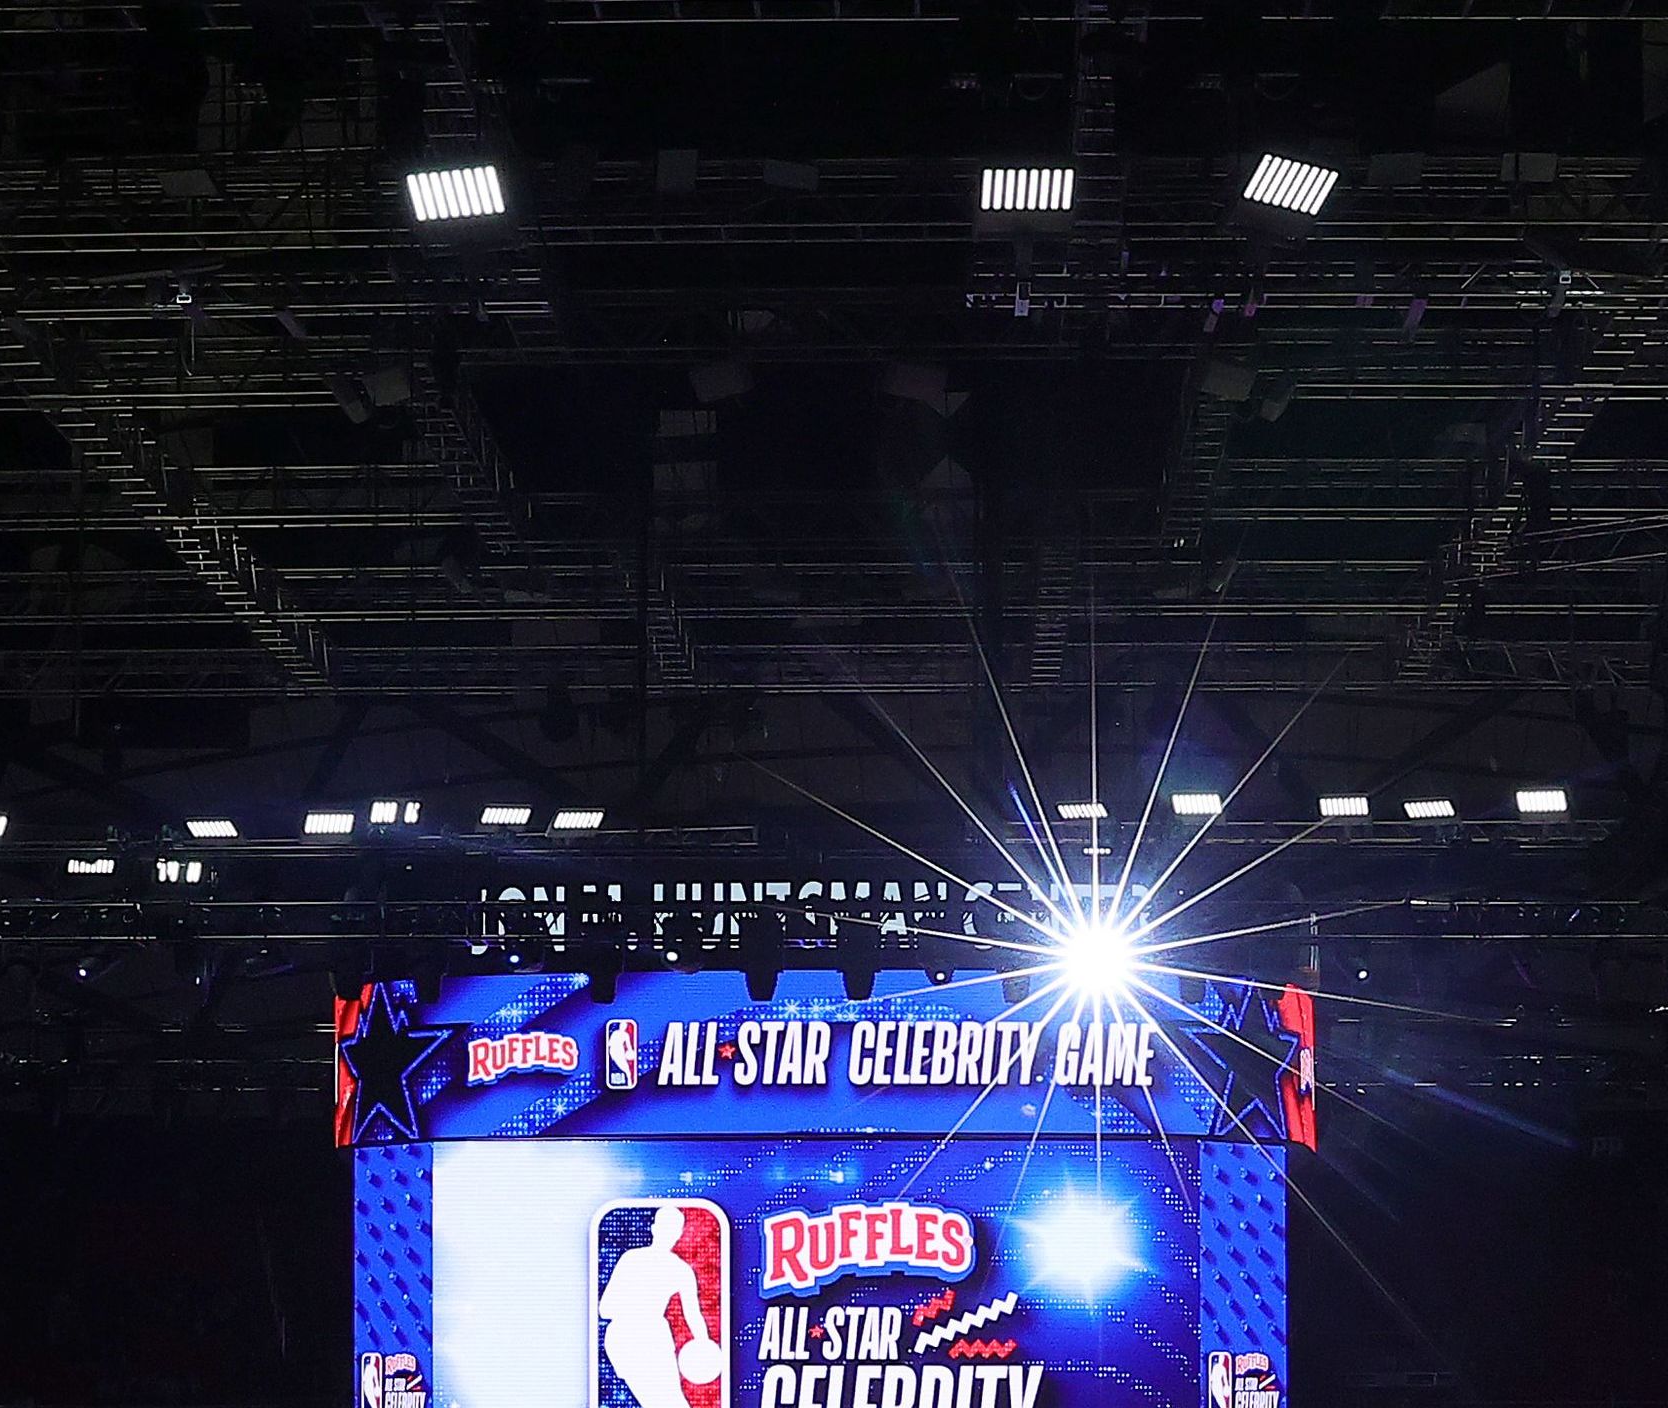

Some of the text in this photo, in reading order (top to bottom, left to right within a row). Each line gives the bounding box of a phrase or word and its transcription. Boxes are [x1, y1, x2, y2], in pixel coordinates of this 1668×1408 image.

[471, 1034, 578, 1078] RUFFLES
[849, 1021, 1038, 1086] CELEBRITY
[1054, 1022, 1157, 1087] GAME
[769, 1208, 968, 1283] RUFFLES
